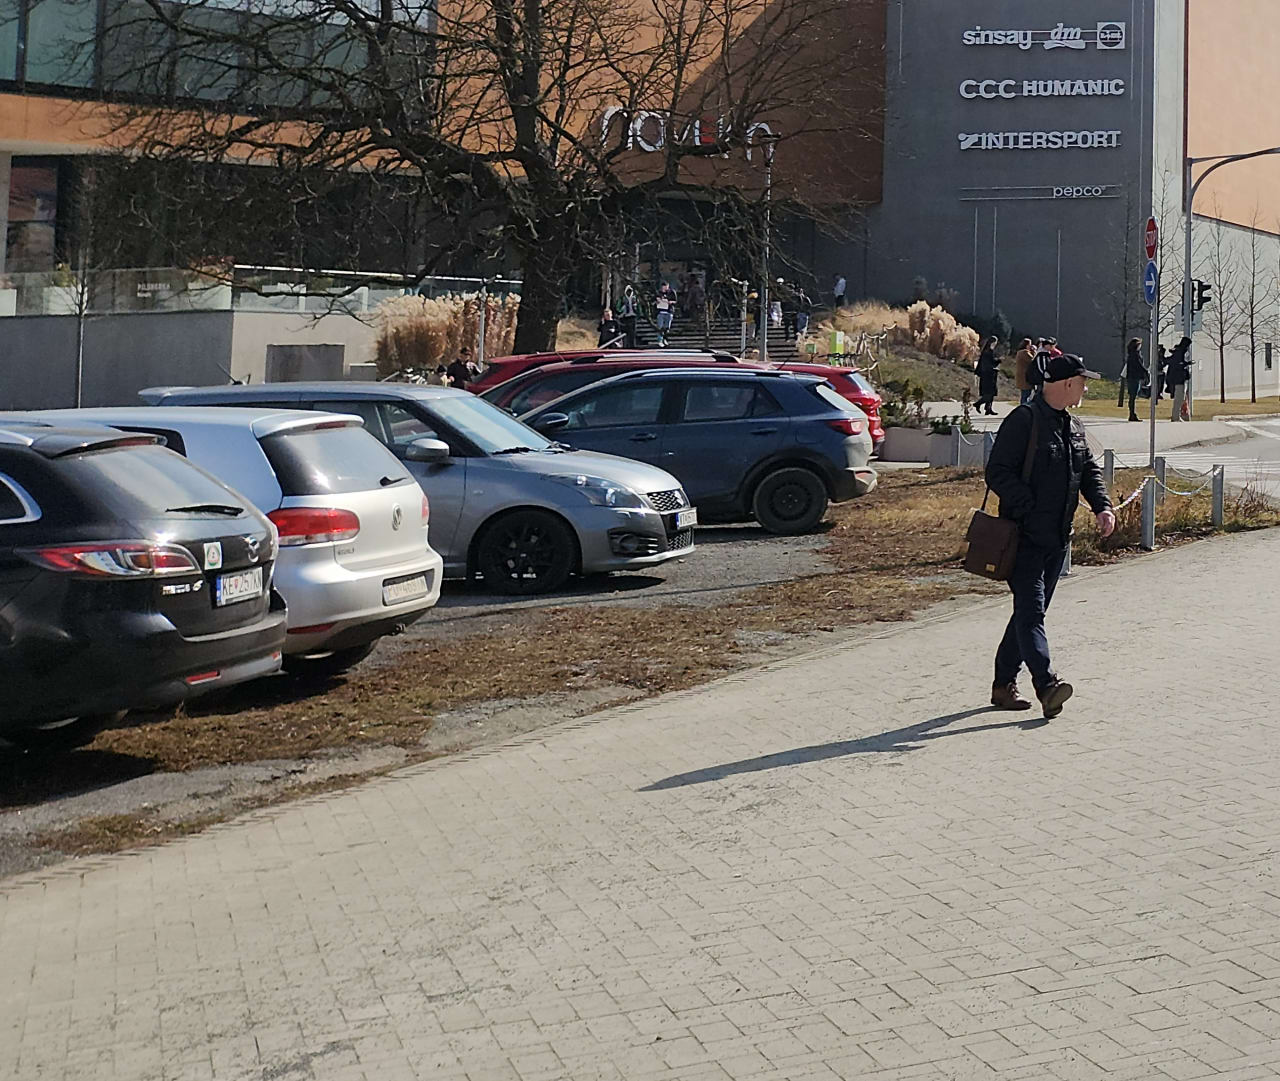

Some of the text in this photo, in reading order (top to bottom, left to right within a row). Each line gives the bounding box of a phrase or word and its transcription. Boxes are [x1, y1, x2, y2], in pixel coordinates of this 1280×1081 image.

[962, 25, 1032, 50] sinsay
[1051, 22, 1082, 41] dm
[959, 78, 1125, 99] CCC HUMANIC
[981, 130, 1121, 150] INTERSPORT
[1053, 186, 1102, 199] pepco
